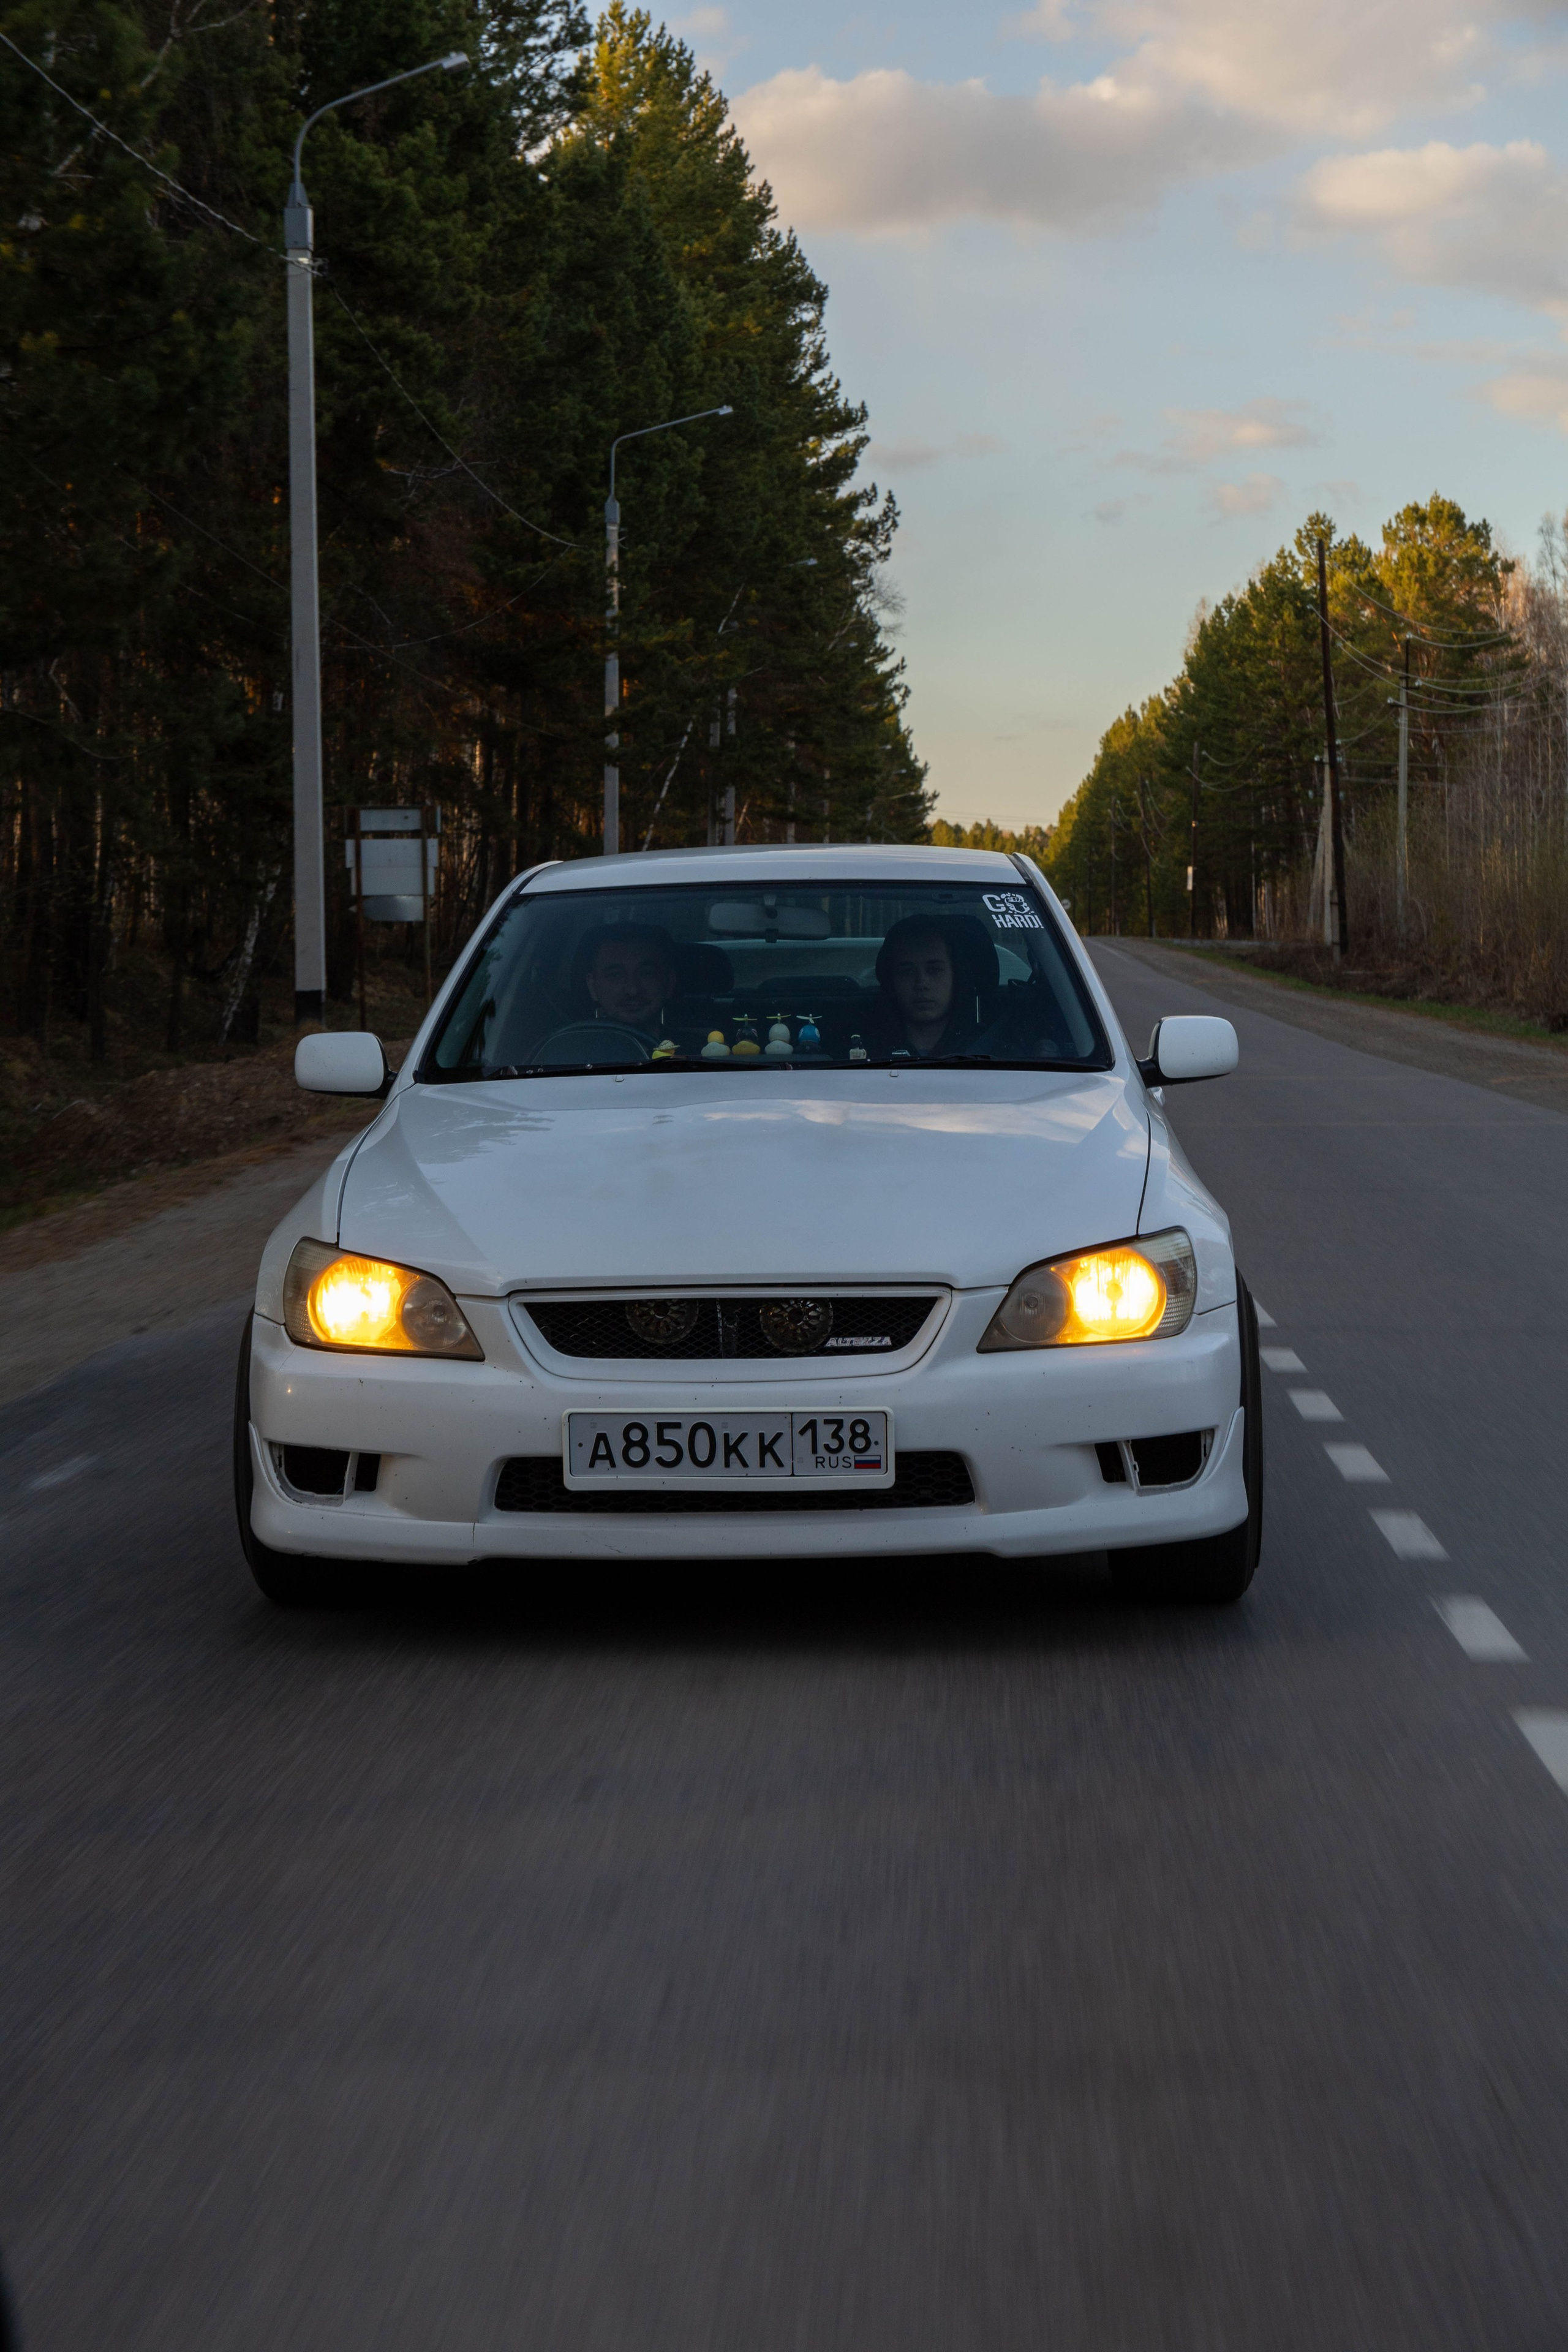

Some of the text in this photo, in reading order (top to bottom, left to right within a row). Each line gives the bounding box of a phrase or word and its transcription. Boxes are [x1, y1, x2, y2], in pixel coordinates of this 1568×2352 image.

[992, 914, 1044, 929] HARD!
[824, 1336, 892, 1347] ALTEZZA
[797, 1419, 872, 1455] 138
[815, 1456, 852, 1469] RUS
